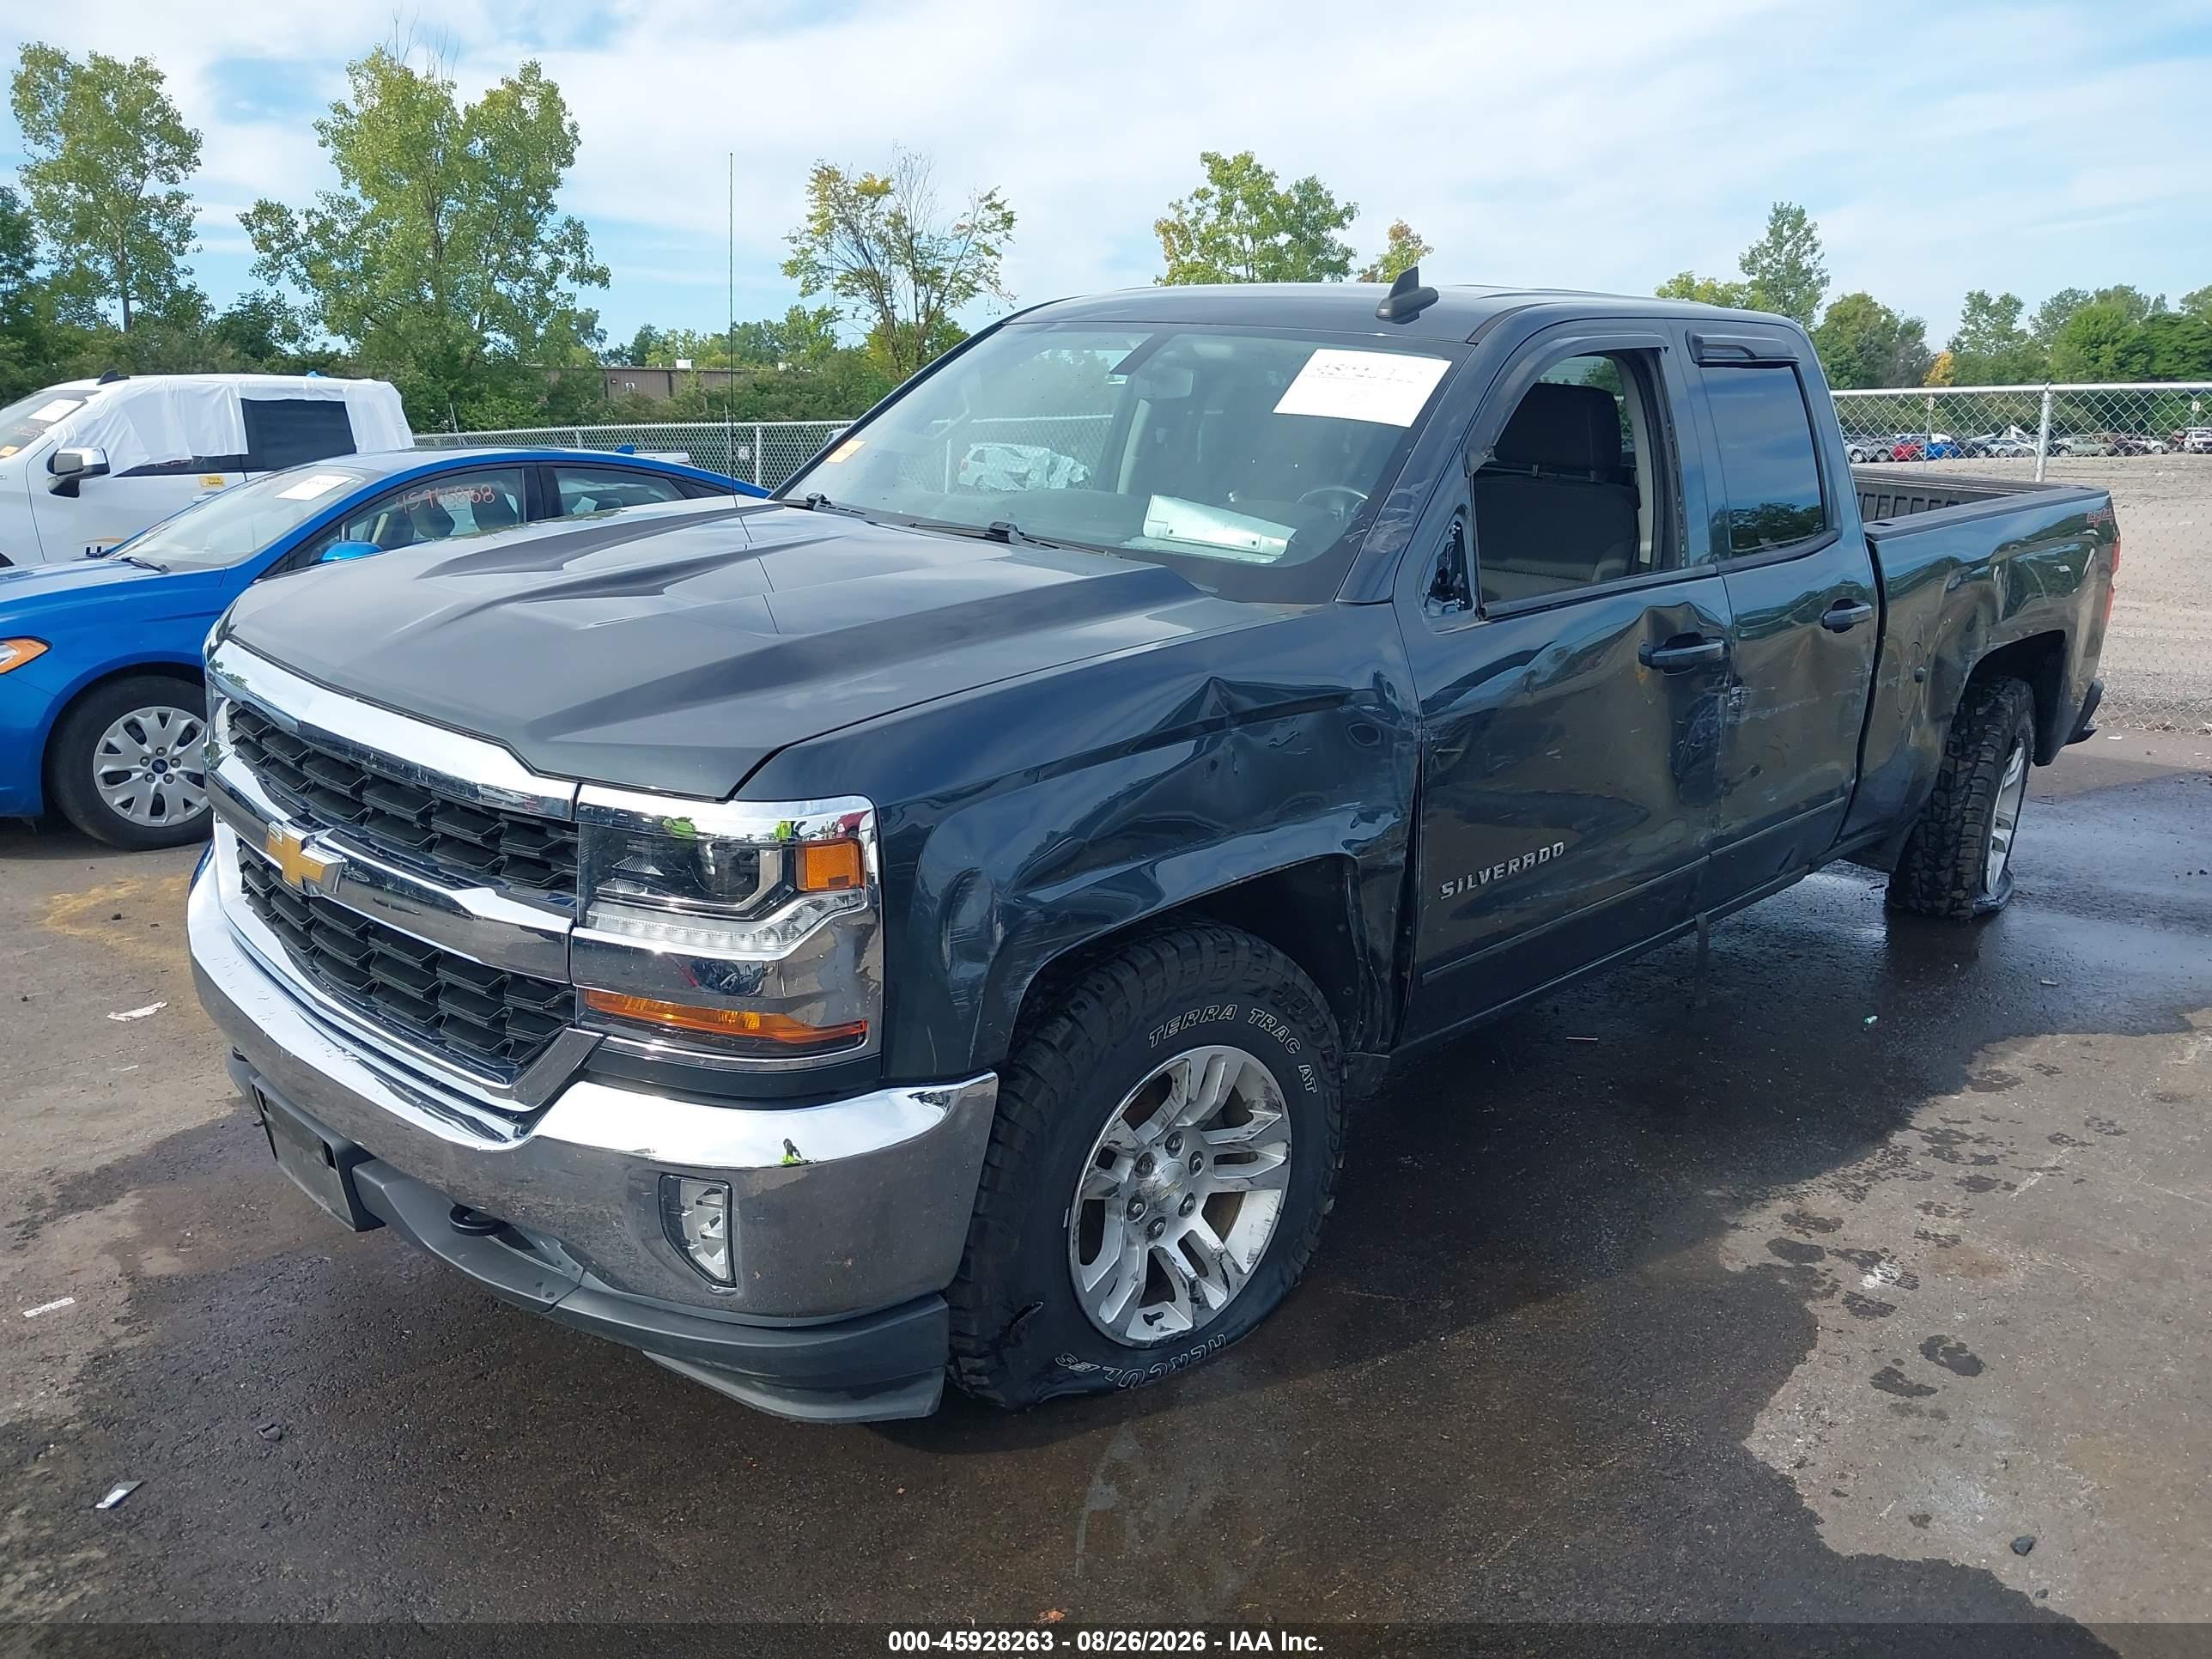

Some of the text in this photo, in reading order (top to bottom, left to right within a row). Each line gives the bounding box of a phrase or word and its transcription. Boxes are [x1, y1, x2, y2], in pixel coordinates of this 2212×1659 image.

[1440, 841, 1565, 900] SILVERADO
[1148, 1004, 1317, 1094] TERRA TRAC AT
